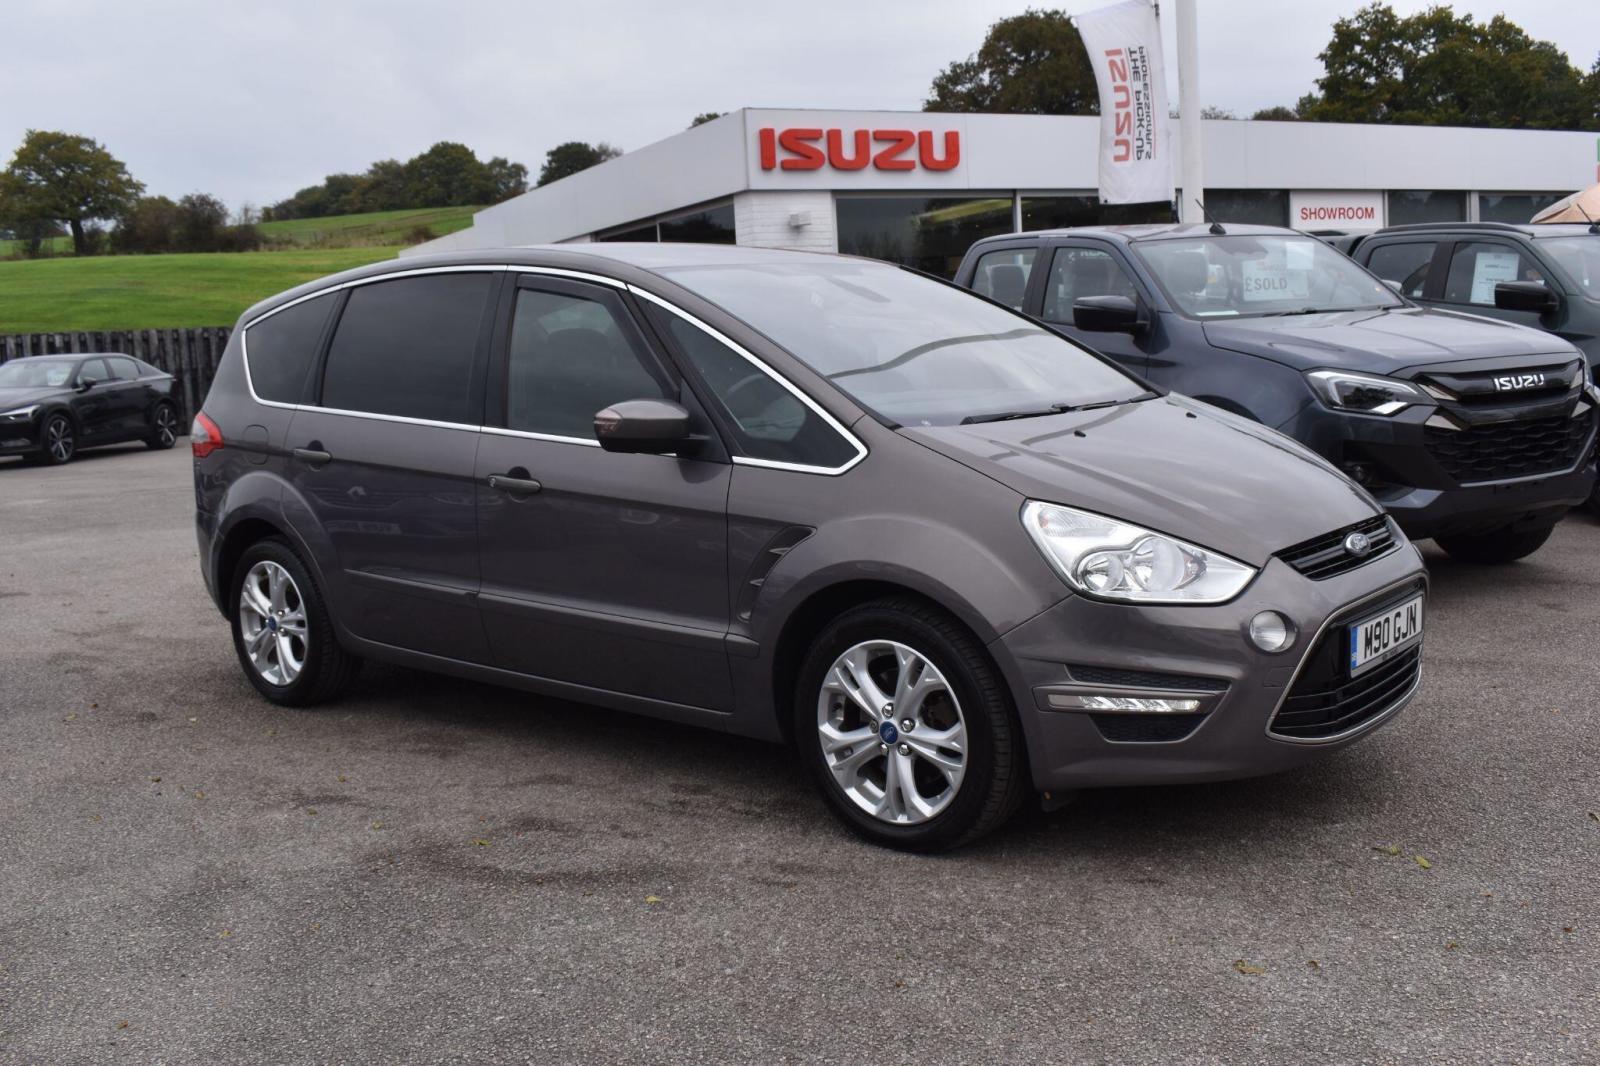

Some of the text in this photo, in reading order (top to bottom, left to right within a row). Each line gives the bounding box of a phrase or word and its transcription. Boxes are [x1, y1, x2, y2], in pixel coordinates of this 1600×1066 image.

[759, 127, 960, 171] ISUZU
[1300, 207, 1375, 220] SHOWROOM
[1493, 373, 1545, 391] ISUZU
[1364, 603, 1417, 659] M90 GJN
